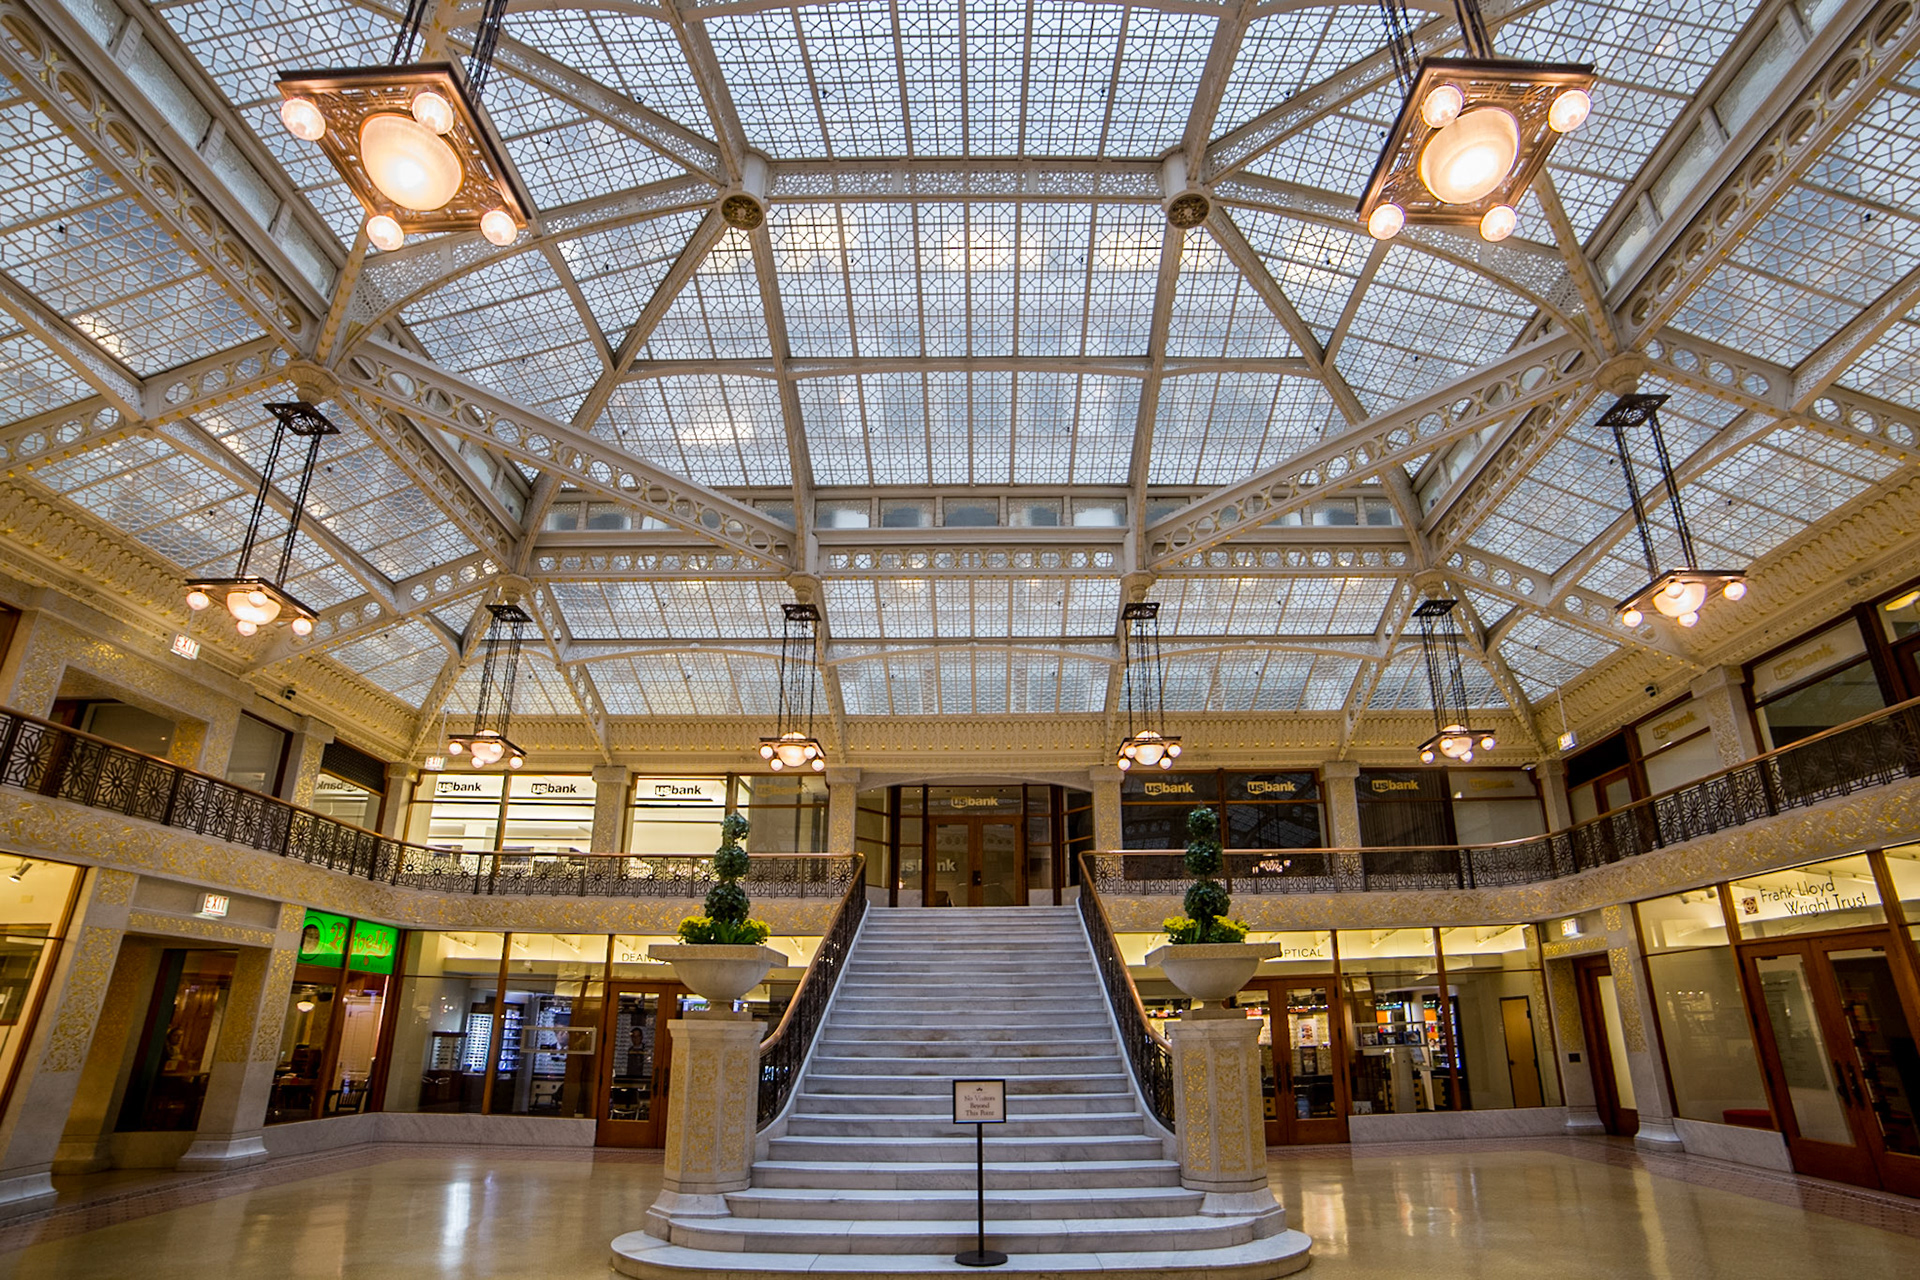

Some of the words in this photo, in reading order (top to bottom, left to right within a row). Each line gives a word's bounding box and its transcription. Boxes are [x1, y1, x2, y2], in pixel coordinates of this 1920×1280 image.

[175, 634, 200, 655] EXIT
[1760, 884, 1795, 903] Frank
[1797, 877, 1835, 896] Lloyd
[205, 894, 228, 911] EXIT
[1784, 898, 1831, 918] Wright
[1833, 892, 1868, 909] Trust
[1282, 948, 1324, 958] PTICAL
